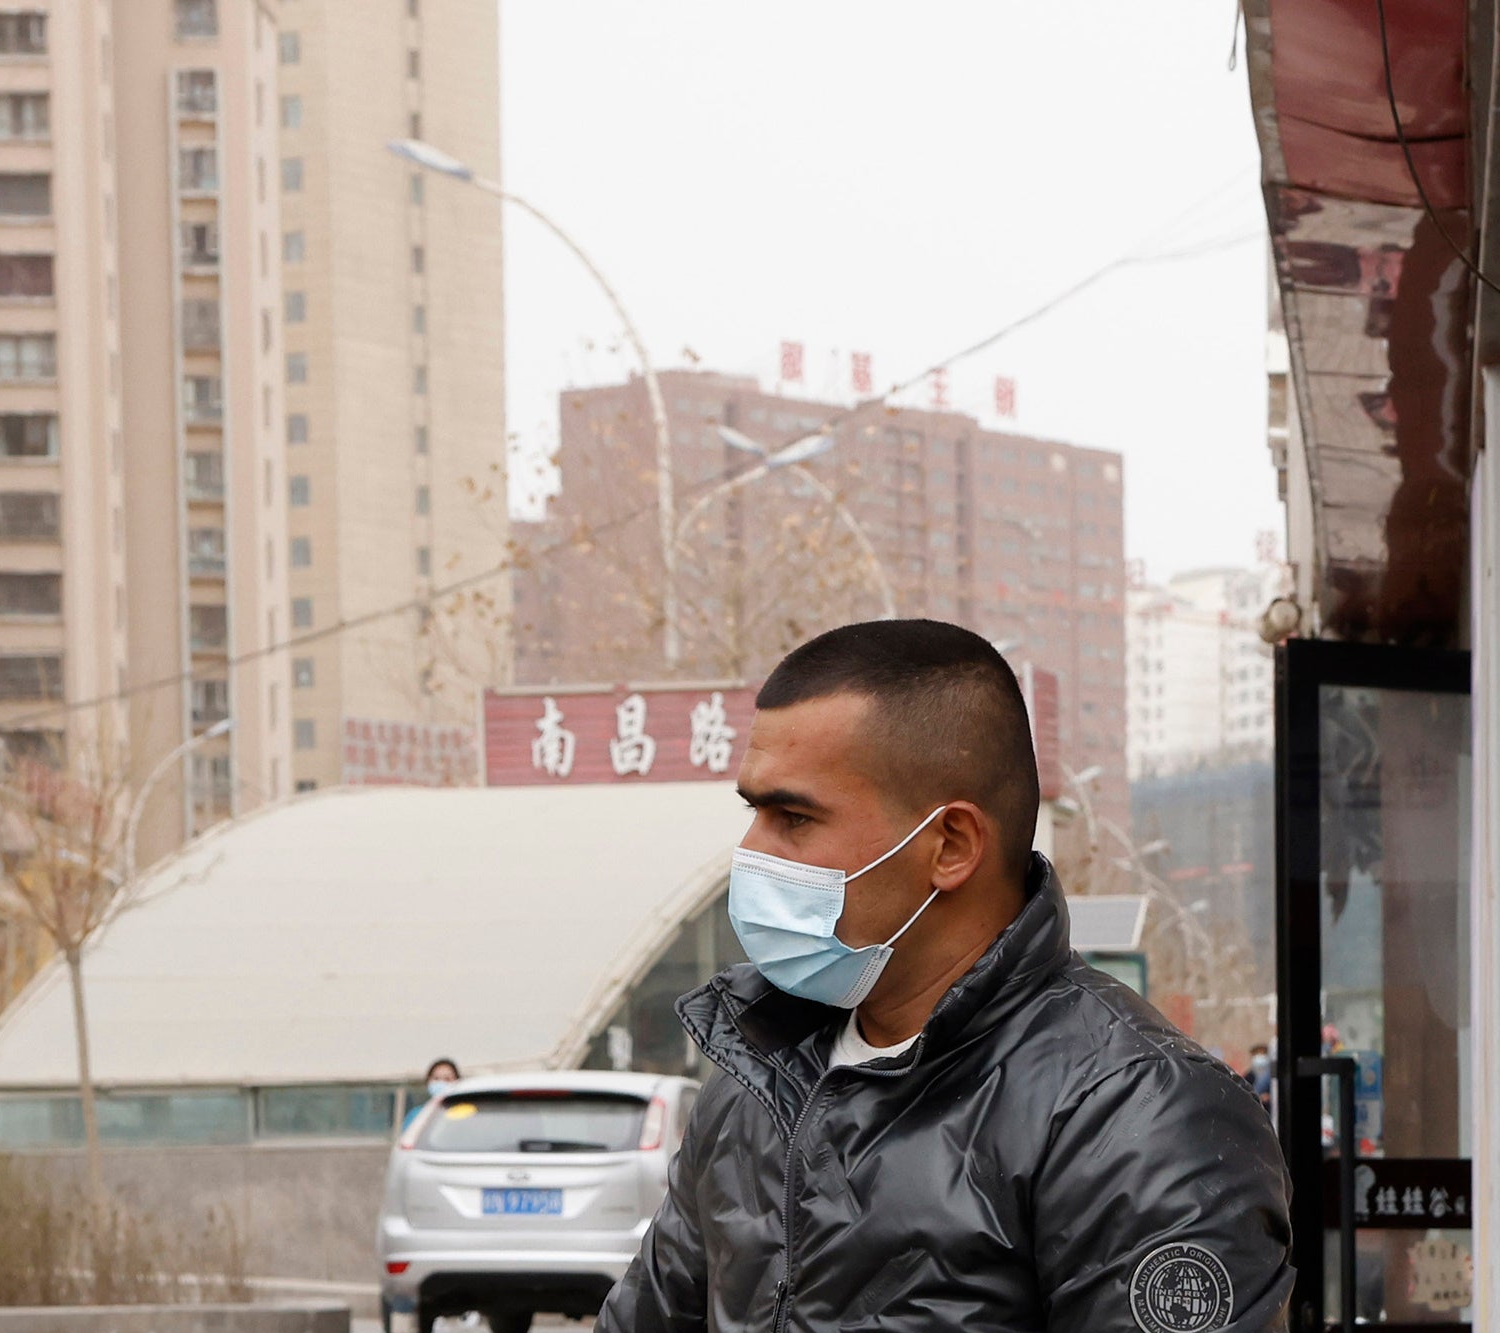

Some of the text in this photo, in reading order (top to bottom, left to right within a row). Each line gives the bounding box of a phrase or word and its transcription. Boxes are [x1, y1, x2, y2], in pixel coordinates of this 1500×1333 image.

[531, 692, 737, 778] 南昌路
[1139, 1248, 1181, 1288] AUTHENTIC
[1158, 1288, 1209, 1299] NEARBY
